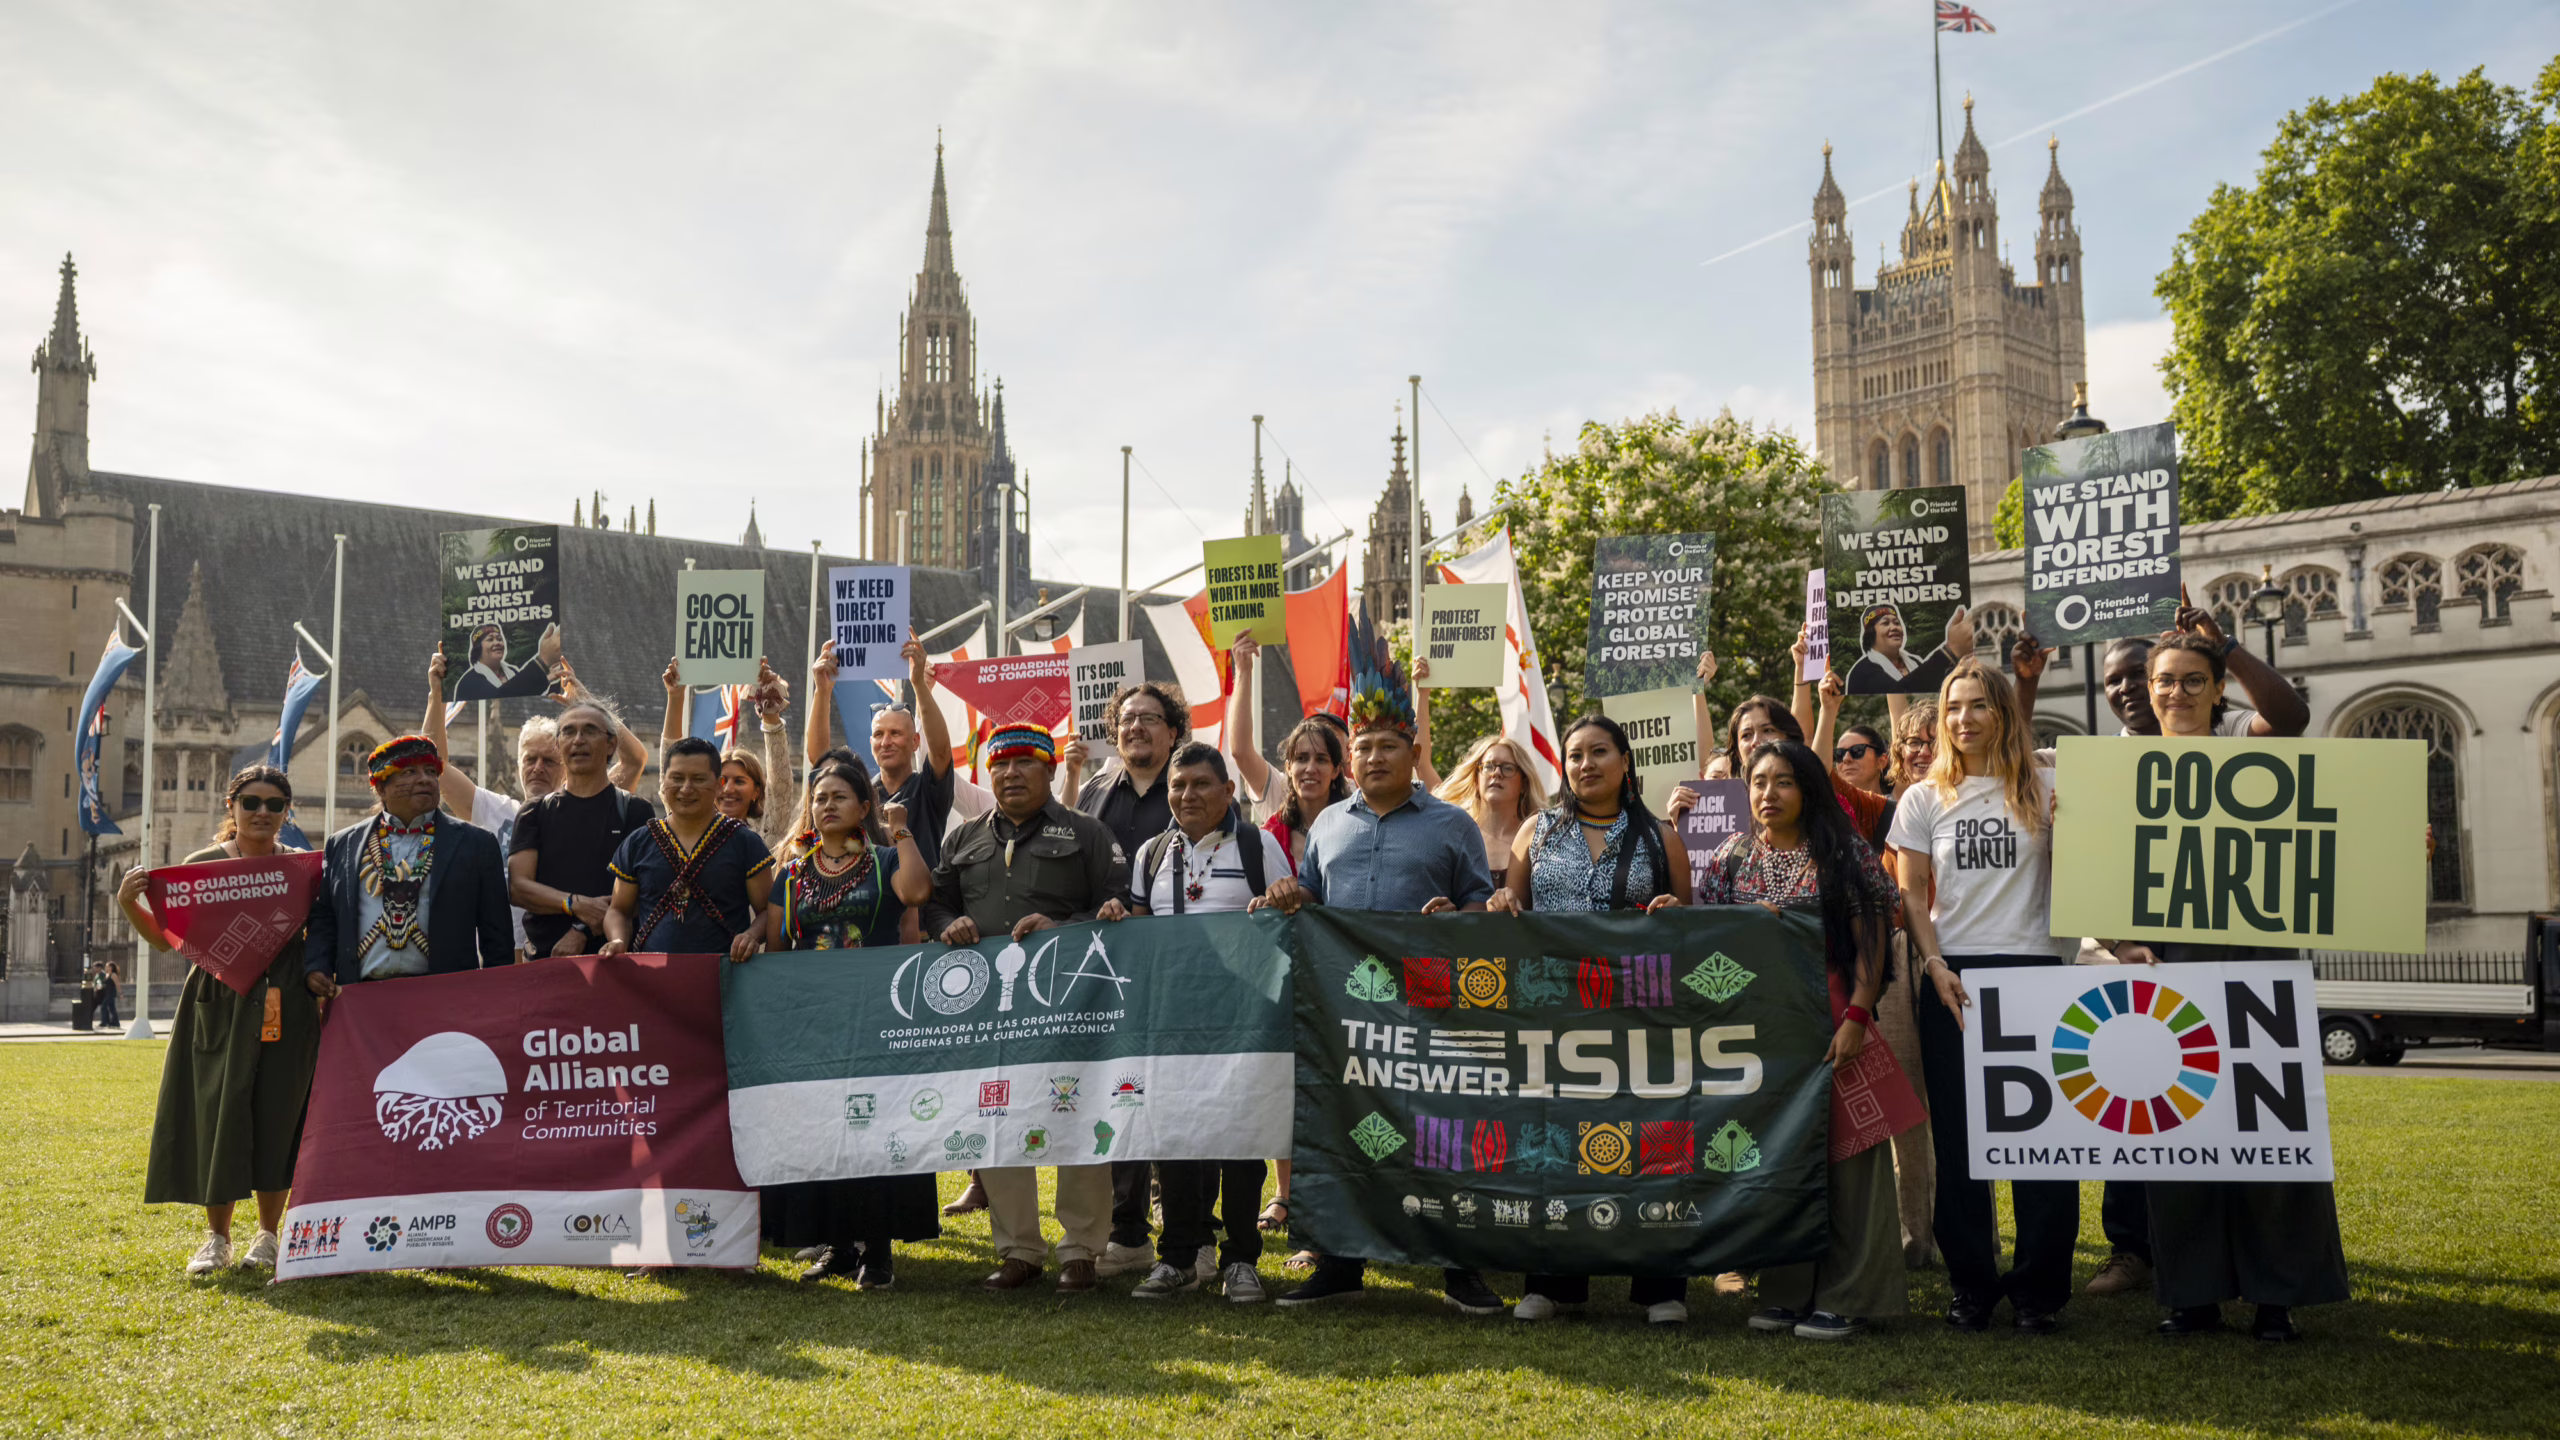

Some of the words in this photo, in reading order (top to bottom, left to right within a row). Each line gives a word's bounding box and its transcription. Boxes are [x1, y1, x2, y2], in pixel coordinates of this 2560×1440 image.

[2033, 483, 2075, 507] WE
[2080, 469, 2169, 500] STAND
[2033, 490, 2170, 543] WITH
[1839, 532, 1873, 550] WE
[1877, 526, 1949, 548] STAND
[1866, 547, 1923, 568] WITH
[2033, 528, 2170, 571] FOREST
[455, 565, 484, 580] WE
[487, 558, 544, 577] STAND
[1208, 564, 1254, 584] FORESTS
[1258, 563, 1278, 579] ARE
[1598, 572, 1647, 589] KEEP
[1651, 567, 1703, 585] YOUR
[1856, 565, 1937, 588] FOREST
[2033, 557, 2170, 591] DEFENDERS
[477, 576, 523, 594] WITH
[836, 580, 855, 599] WE
[859, 579, 894, 598] NEED
[1210, 585, 1247, 603] WORTH
[1249, 582, 1280, 599] MORE
[1836, 583, 1962, 608] DEFENDERS
[468, 590, 534, 610] FOREST
[686, 593, 754, 619] COOL
[1604, 586, 1698, 606] PROMISE:
[2094, 595, 2135, 610] Friends
[2138, 593, 2150, 604] of
[450, 604, 552, 628] DEFENDERS
[836, 601, 885, 622] DIRECT
[1212, 602, 1264, 622] STANDING
[1432, 609, 1480, 625] PROTECT
[1604, 604, 1696, 625] PROTECT
[2094, 610, 2114, 621] the
[2116, 605, 2149, 618] Earth
[685, 621, 754, 659] EARTH
[837, 624, 896, 645] FUNDING
[1431, 626, 1496, 642] RAINFOREST
[1609, 623, 1689, 643] GLOBAL
[836, 647, 866, 667] NOW
[1430, 644, 1454, 659] NOW
[1601, 641, 1698, 662] FORESTS!
[978, 674, 996, 684] NO
[980, 664, 998, 674] NO
[1099, 661, 1126, 678] COOL
[1078, 685, 1091, 701] TO
[1620, 716, 1671, 741] ROTECT
[2135, 750, 2338, 822] COOL
[1688, 814, 1736, 833] PEOPLE
[1956, 817, 2016, 838] COOL
[1955, 837, 2016, 870] EARTH
[166, 882, 191, 894] NO
[194, 871, 284, 891] GUARDIANS
[2132, 824, 2338, 936] EARTH
[165, 895, 191, 908] NO
[193, 883, 288, 904] TOMORROW
[880, 1024, 974, 1039] COORDINADORA
[978, 1022, 993, 1031] DE
[997, 1019, 1017, 1029] LAS
[1022, 1009, 1125, 1026] ORGANIZACIONES
[523, 1024, 640, 1057] Global
[889, 1036, 951, 1049] INDÍGENAS
[956, 1034, 970, 1044] DE
[975, 1033, 989, 1042] LA
[993, 1030, 1038, 1041] CUENCA
[1043, 1022, 1116, 1036] AMAZÓNICA
[1341, 1019, 1418, 1055] THE
[523, 1061, 669, 1092] Alliance
[1342, 1055, 1510, 1096] ANSWER
[525, 1100, 548, 1121] of
[554, 1095, 655, 1118] Territorial
[522, 1118, 657, 1139] Communities
[946, 1152, 971, 1160] OPIAC
[1986, 1146, 2102, 1165] CLIMATE
[2112, 1147, 2220, 1165] ACTION
[2230, 1146, 2313, 1165] WEEK
[408, 1214, 456, 1231] AMPB
